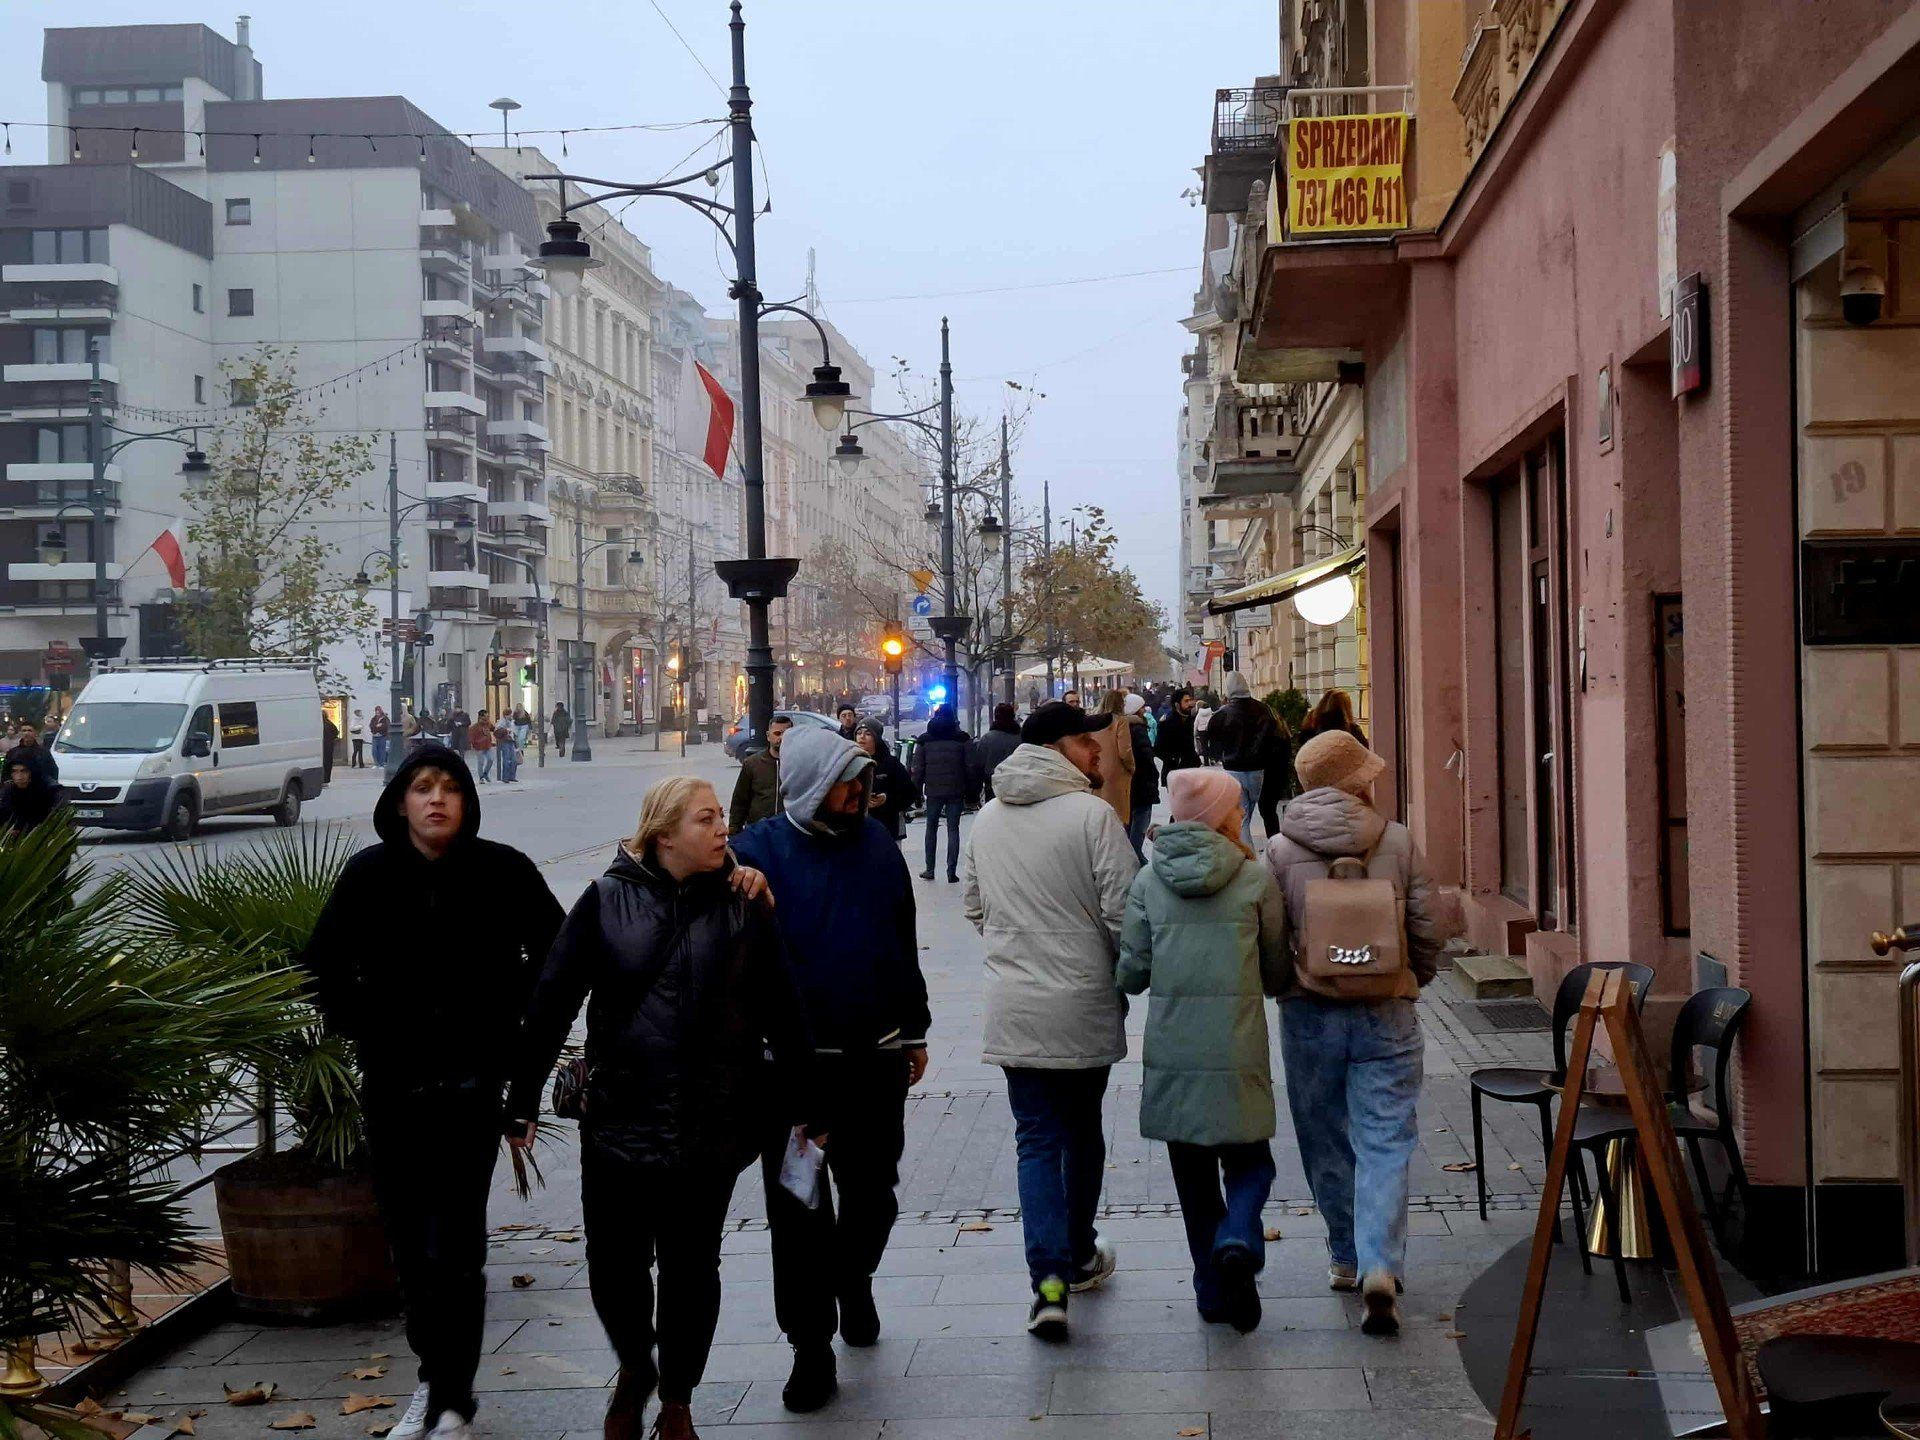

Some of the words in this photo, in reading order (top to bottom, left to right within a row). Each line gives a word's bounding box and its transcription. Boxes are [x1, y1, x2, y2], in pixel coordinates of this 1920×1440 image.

[1296, 118, 1402, 169] SPRZEDAM
[1296, 179, 1327, 227] 737
[1331, 177, 1368, 226] 466
[1372, 176, 1402, 224] 411
